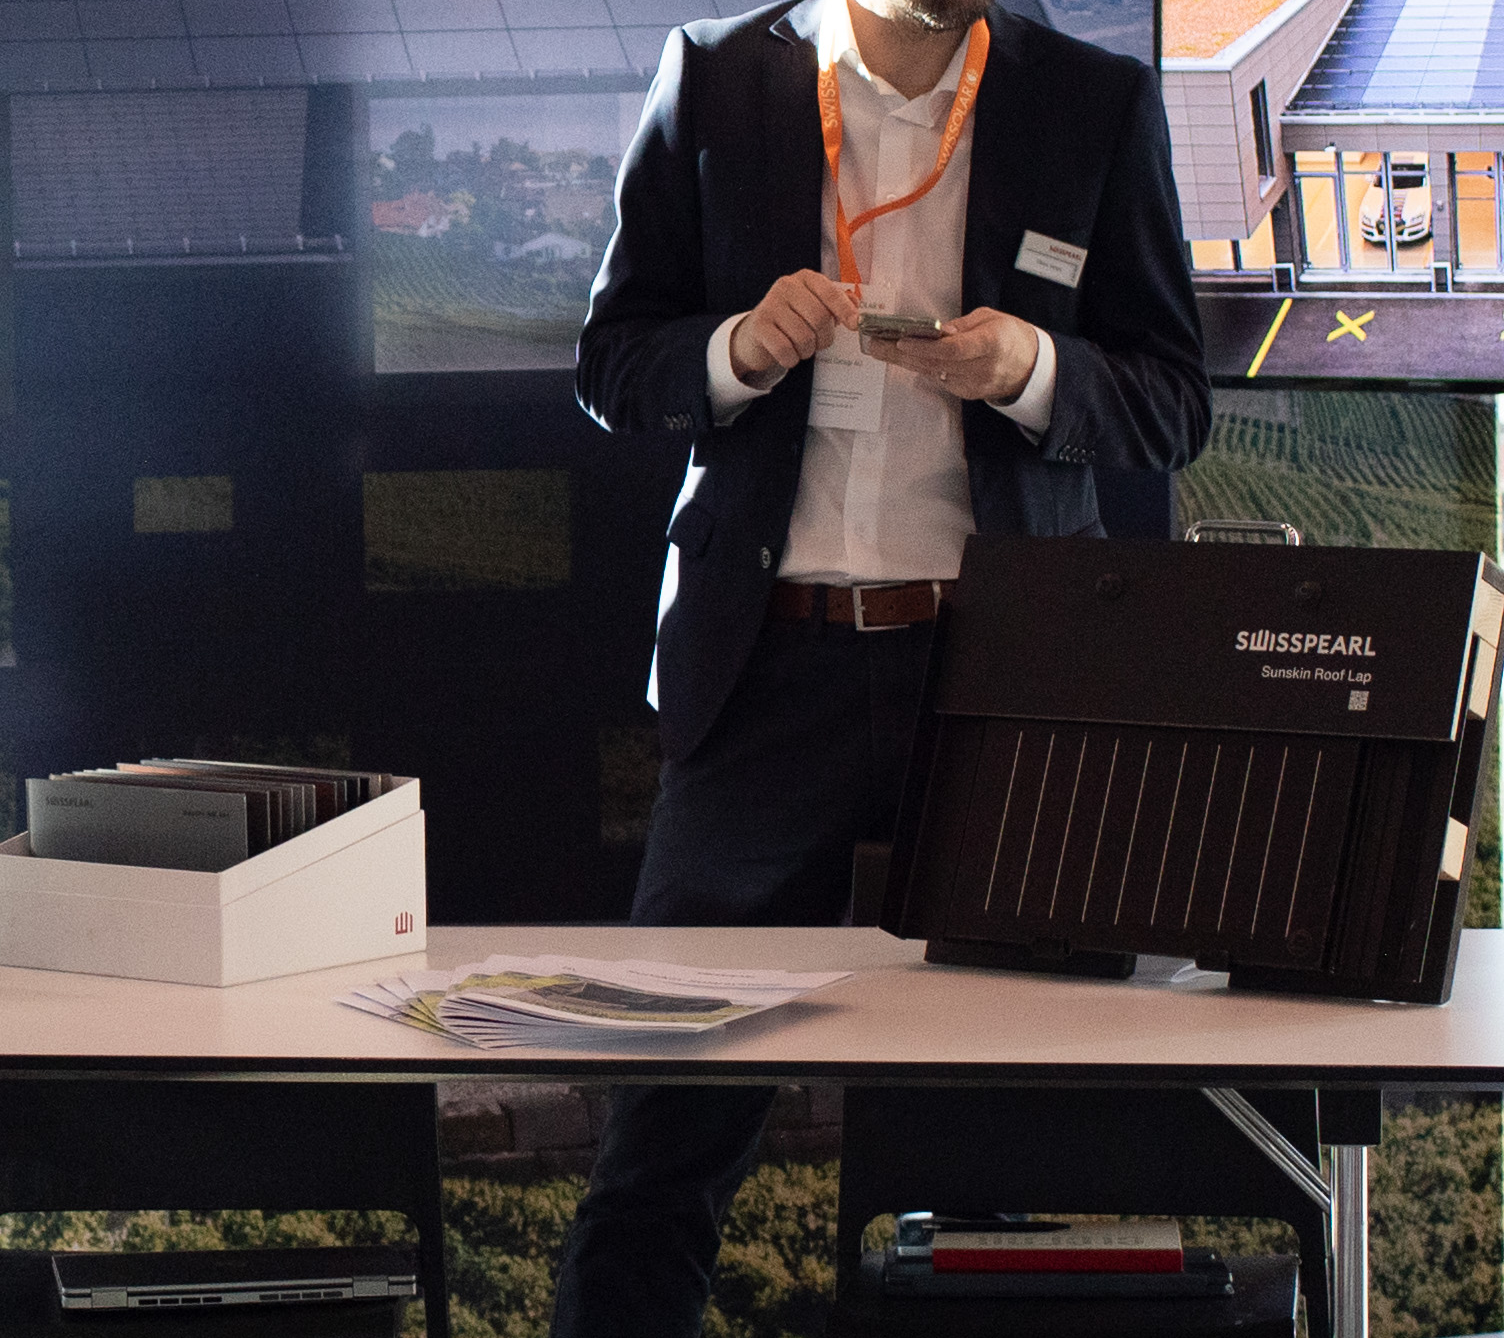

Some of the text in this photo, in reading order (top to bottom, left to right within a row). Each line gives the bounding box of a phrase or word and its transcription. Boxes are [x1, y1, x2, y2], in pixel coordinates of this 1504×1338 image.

[820, 67, 839, 128] SWISSO
[1235, 628, 1377, 657] SWISSPEARL
[1261, 664, 1372, 685] Sunskin Roof Lap
